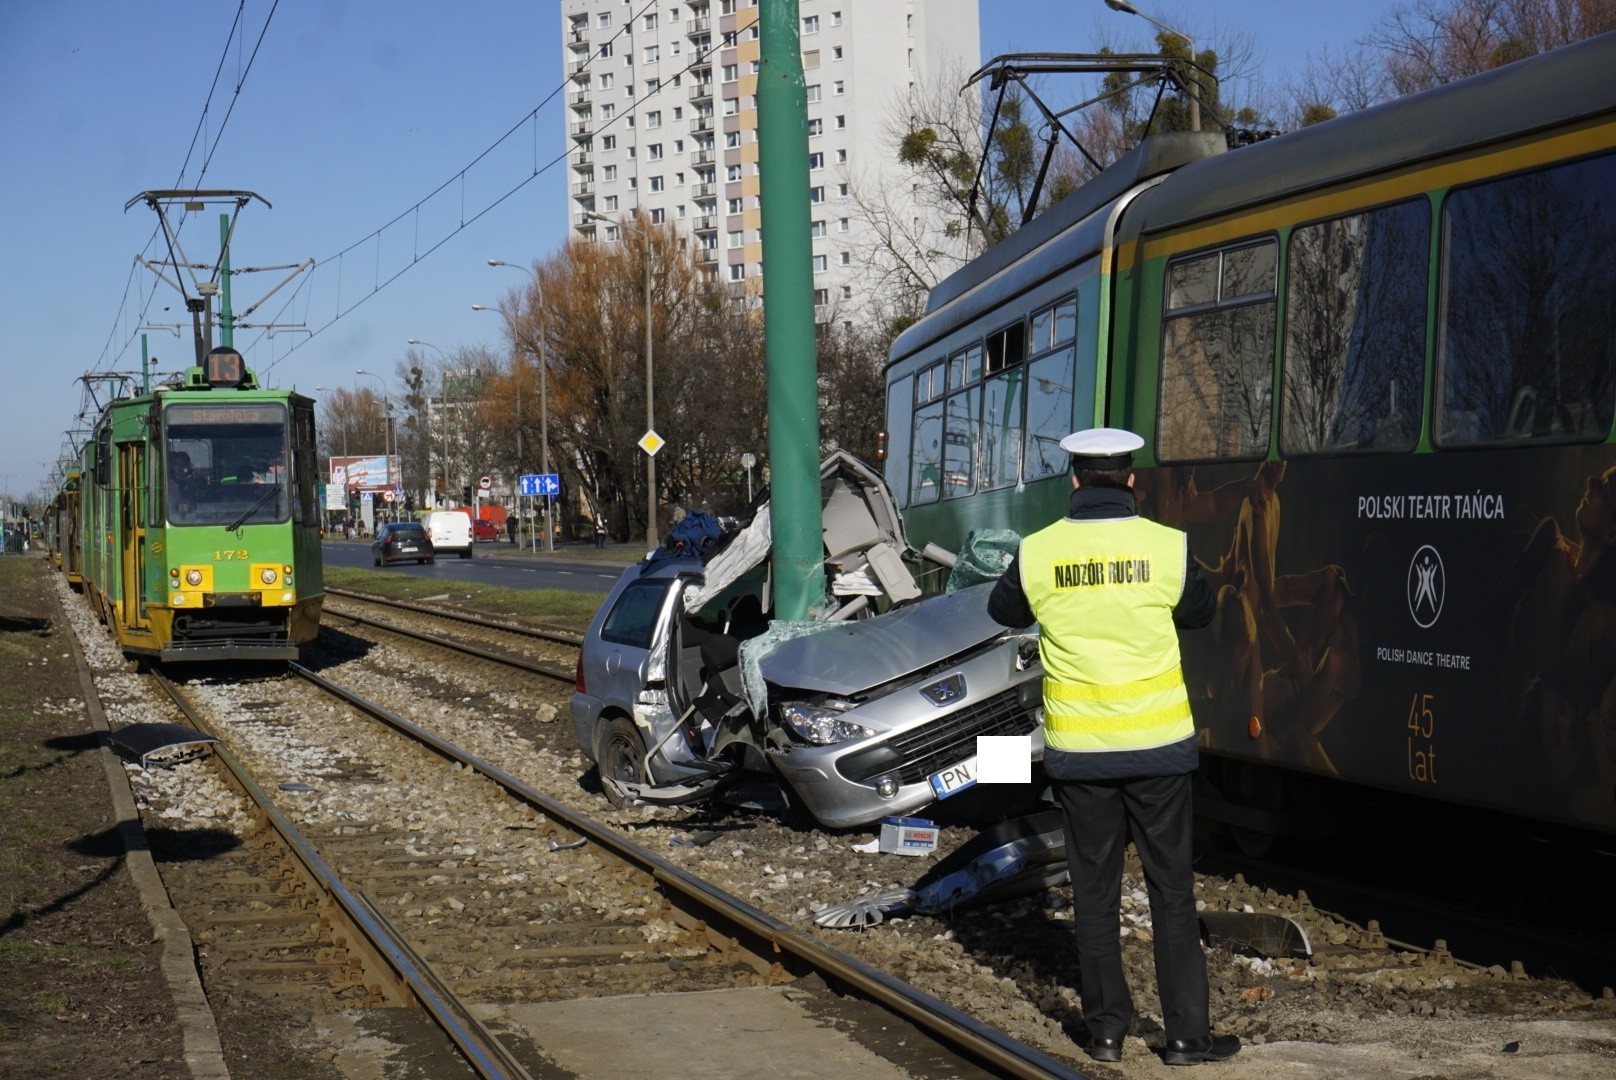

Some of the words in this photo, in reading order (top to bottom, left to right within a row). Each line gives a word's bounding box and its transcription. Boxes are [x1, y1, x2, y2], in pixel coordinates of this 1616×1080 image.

[210, 354, 239, 381] 13
[1358, 496, 1405, 519] POLSKI
[1408, 495, 1450, 519] TEATR
[1454, 490, 1504, 519] TAŃCA
[214, 550, 249, 561] 172
[1055, 558, 1104, 588] NADZÓR
[1108, 560, 1150, 584] RUCHU
[1377, 647, 1405, 662] POLISH
[1406, 650, 1433, 666] DANCE
[1436, 652, 1471, 670] THEATRE
[1407, 693, 1434, 739] 45
[1408, 737, 1437, 784] lat
[942, 764, 971, 790] PN
[913, 831, 932, 840] BOSCH
